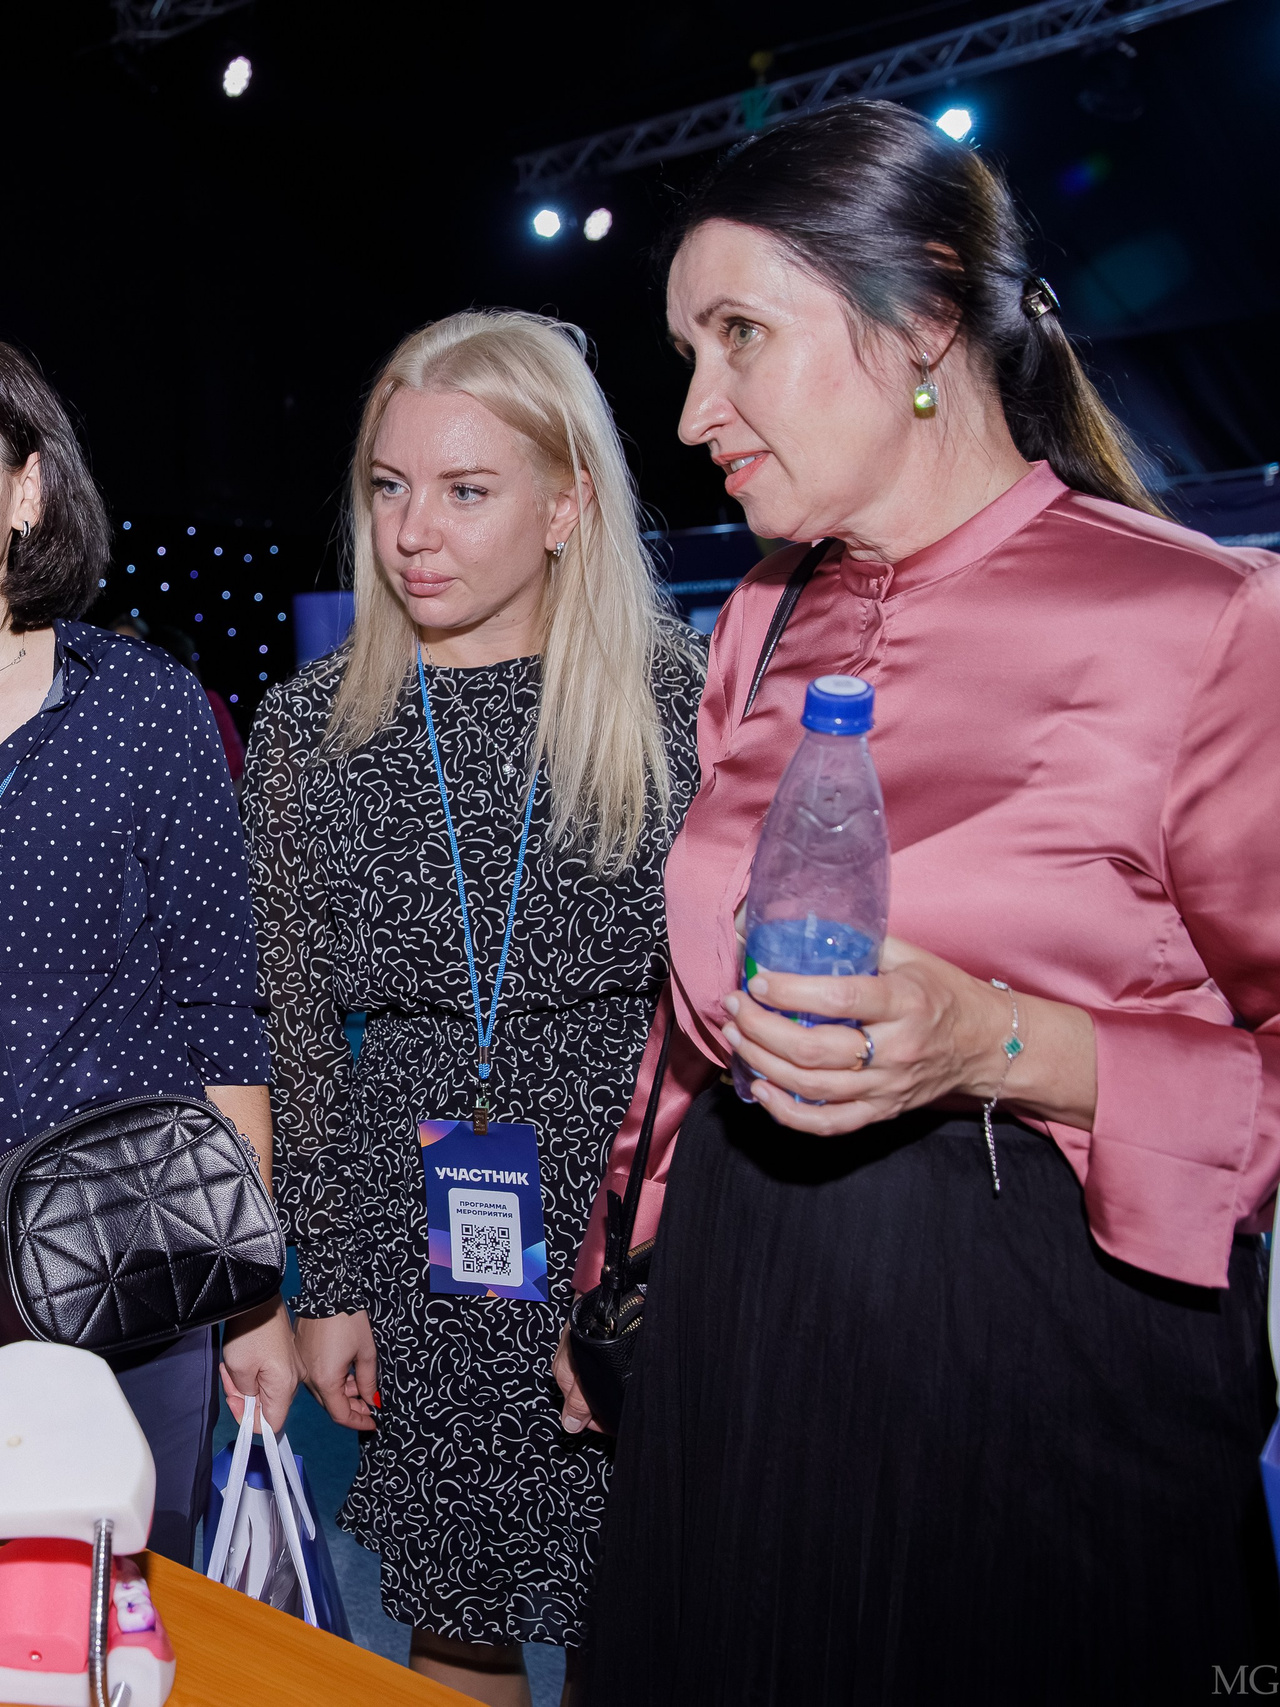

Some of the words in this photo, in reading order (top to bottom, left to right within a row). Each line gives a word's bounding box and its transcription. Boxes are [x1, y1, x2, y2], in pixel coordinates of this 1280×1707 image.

[434, 1166, 529, 1186] УЧАСТНИК
[459, 1200, 508, 1211] ПРОГРАММА
[456, 1208, 513, 1219] МЕРОПРИЯТИЯ
